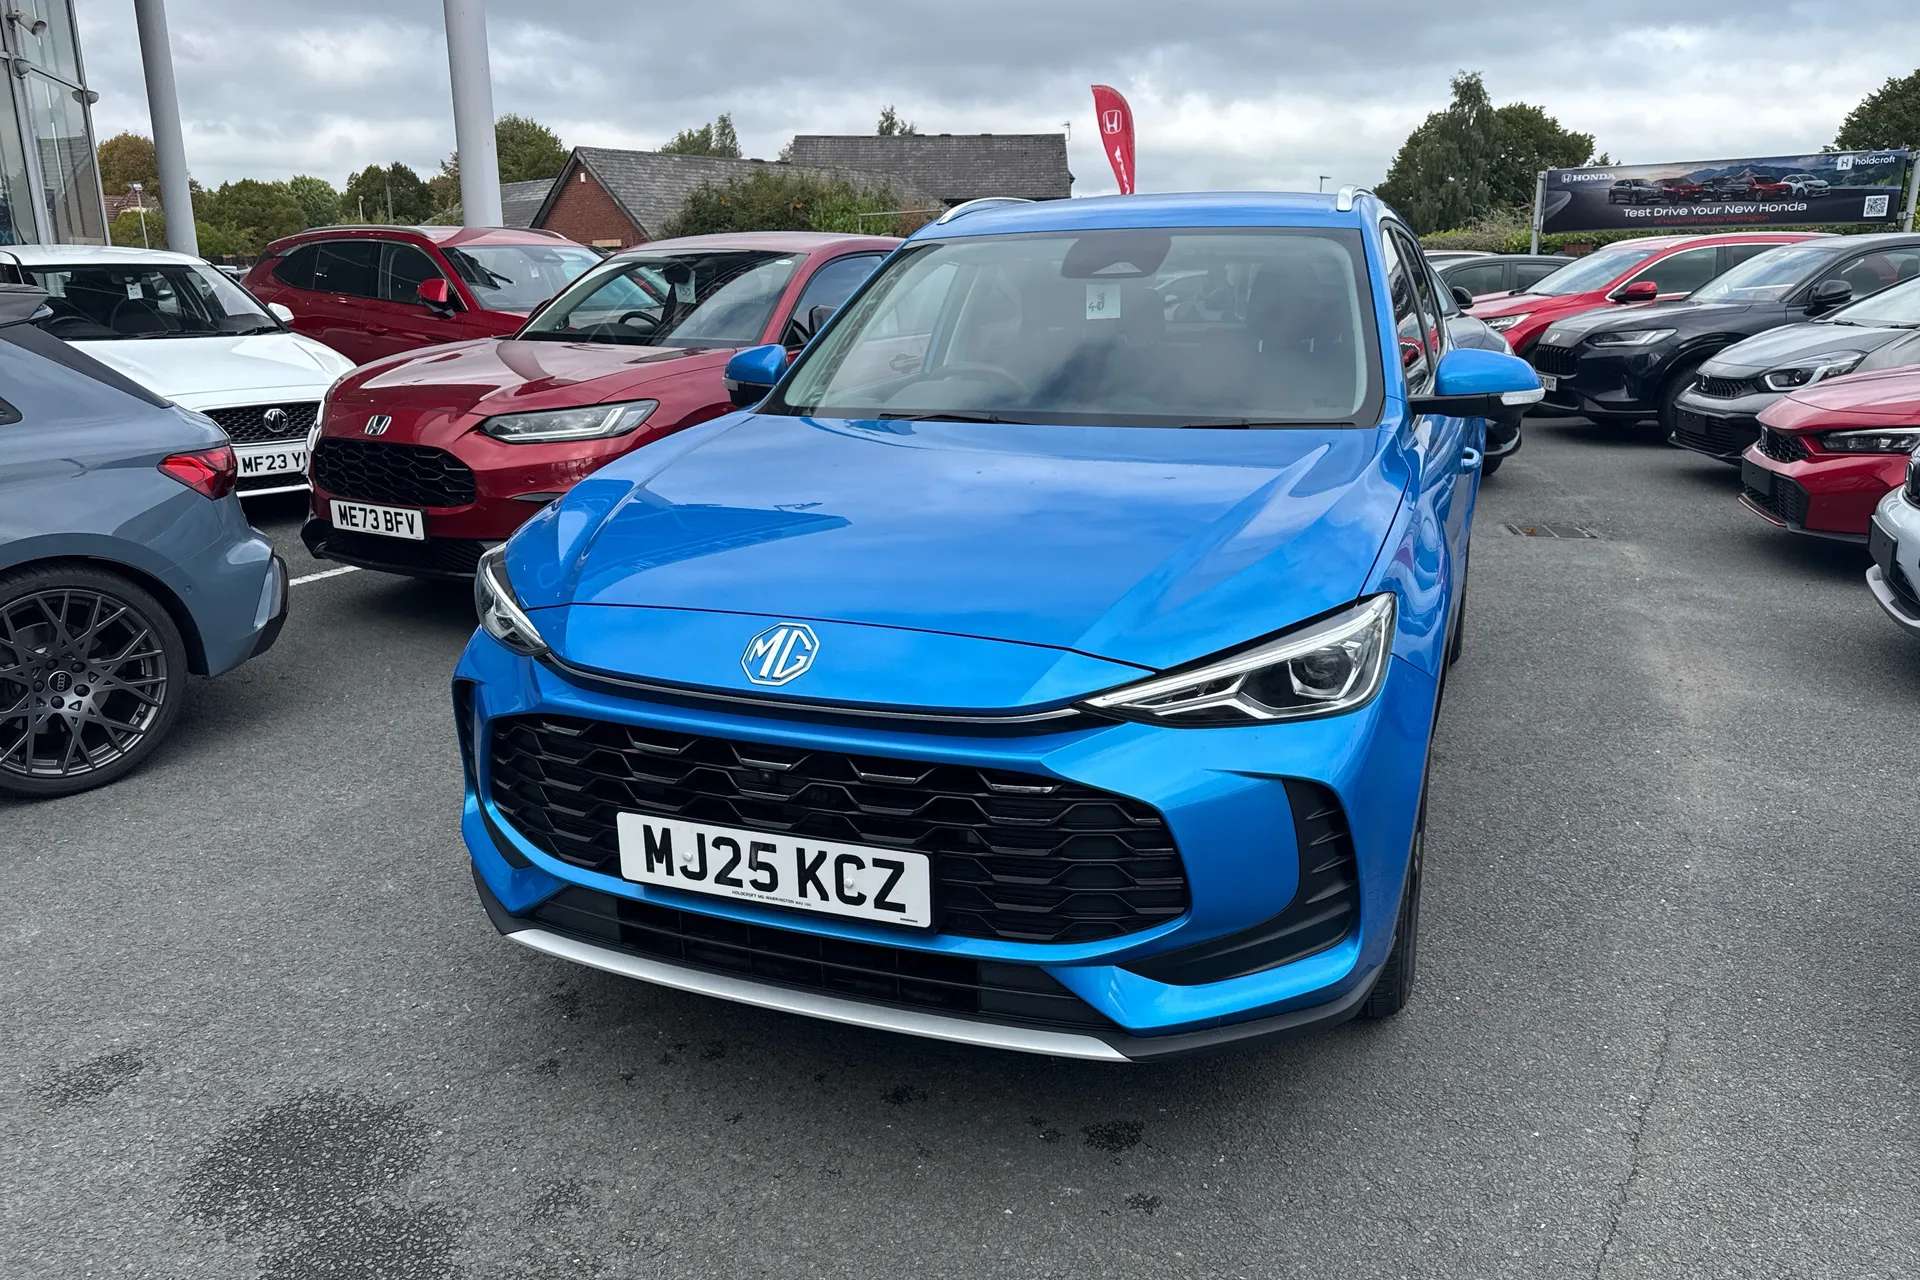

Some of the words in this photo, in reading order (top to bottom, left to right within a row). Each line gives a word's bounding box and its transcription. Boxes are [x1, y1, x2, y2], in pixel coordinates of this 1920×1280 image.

[1855, 155, 1896, 166] holdcroft
[1572, 173, 1616, 182] HONDA
[1623, 208, 1652, 218] Test
[1653, 206, 1688, 217] Drive
[1691, 205, 1722, 216] Your
[1724, 204, 1756, 214] New
[1759, 201, 1807, 213] Honda
[241, 453, 288, 473] MF23
[338, 504, 380, 530] ME73
[382, 510, 414, 535] BFV
[746, 626, 814, 681] MG
[642, 823, 779, 893] MJ25
[795, 846, 907, 914] KCZ
